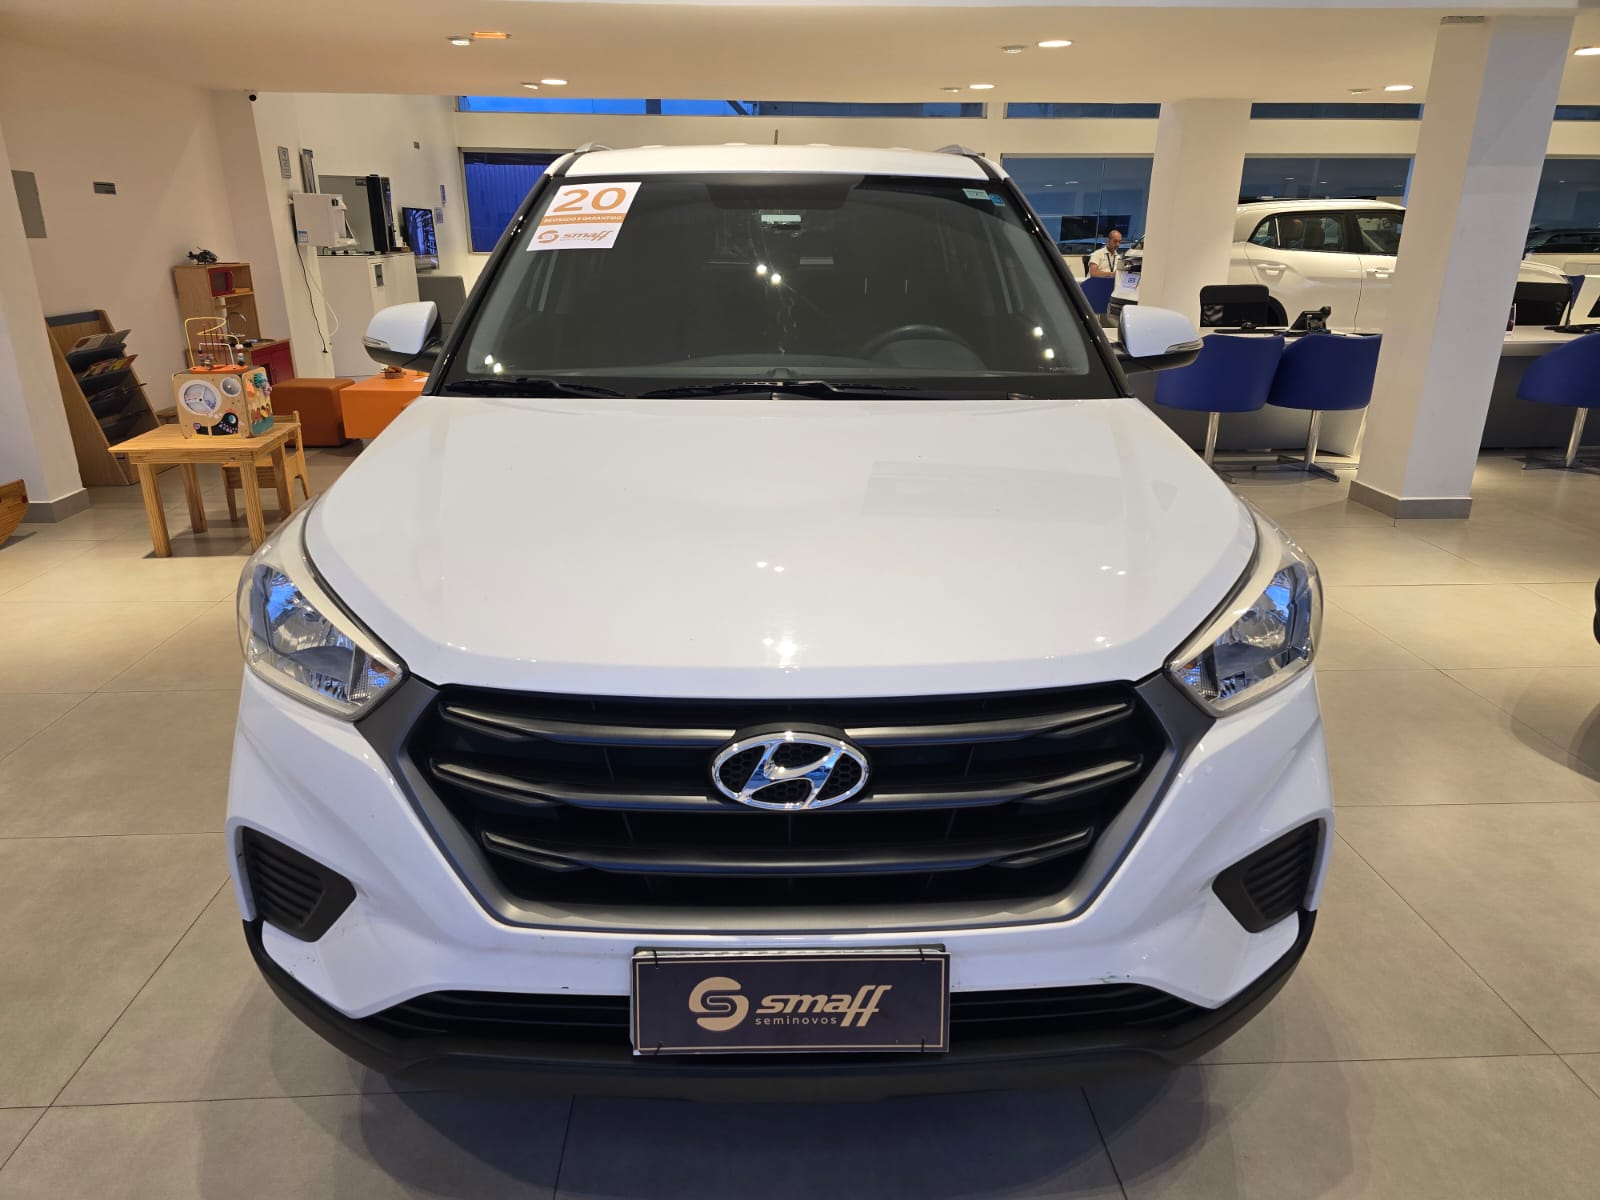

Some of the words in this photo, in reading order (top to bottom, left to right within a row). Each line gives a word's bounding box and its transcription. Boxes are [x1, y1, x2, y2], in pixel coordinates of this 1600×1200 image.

[553, 187, 627, 212] 20
[563, 231, 613, 240] smaff
[755, 984, 893, 1027] smaff
[755, 1016, 837, 1025] seminovos
